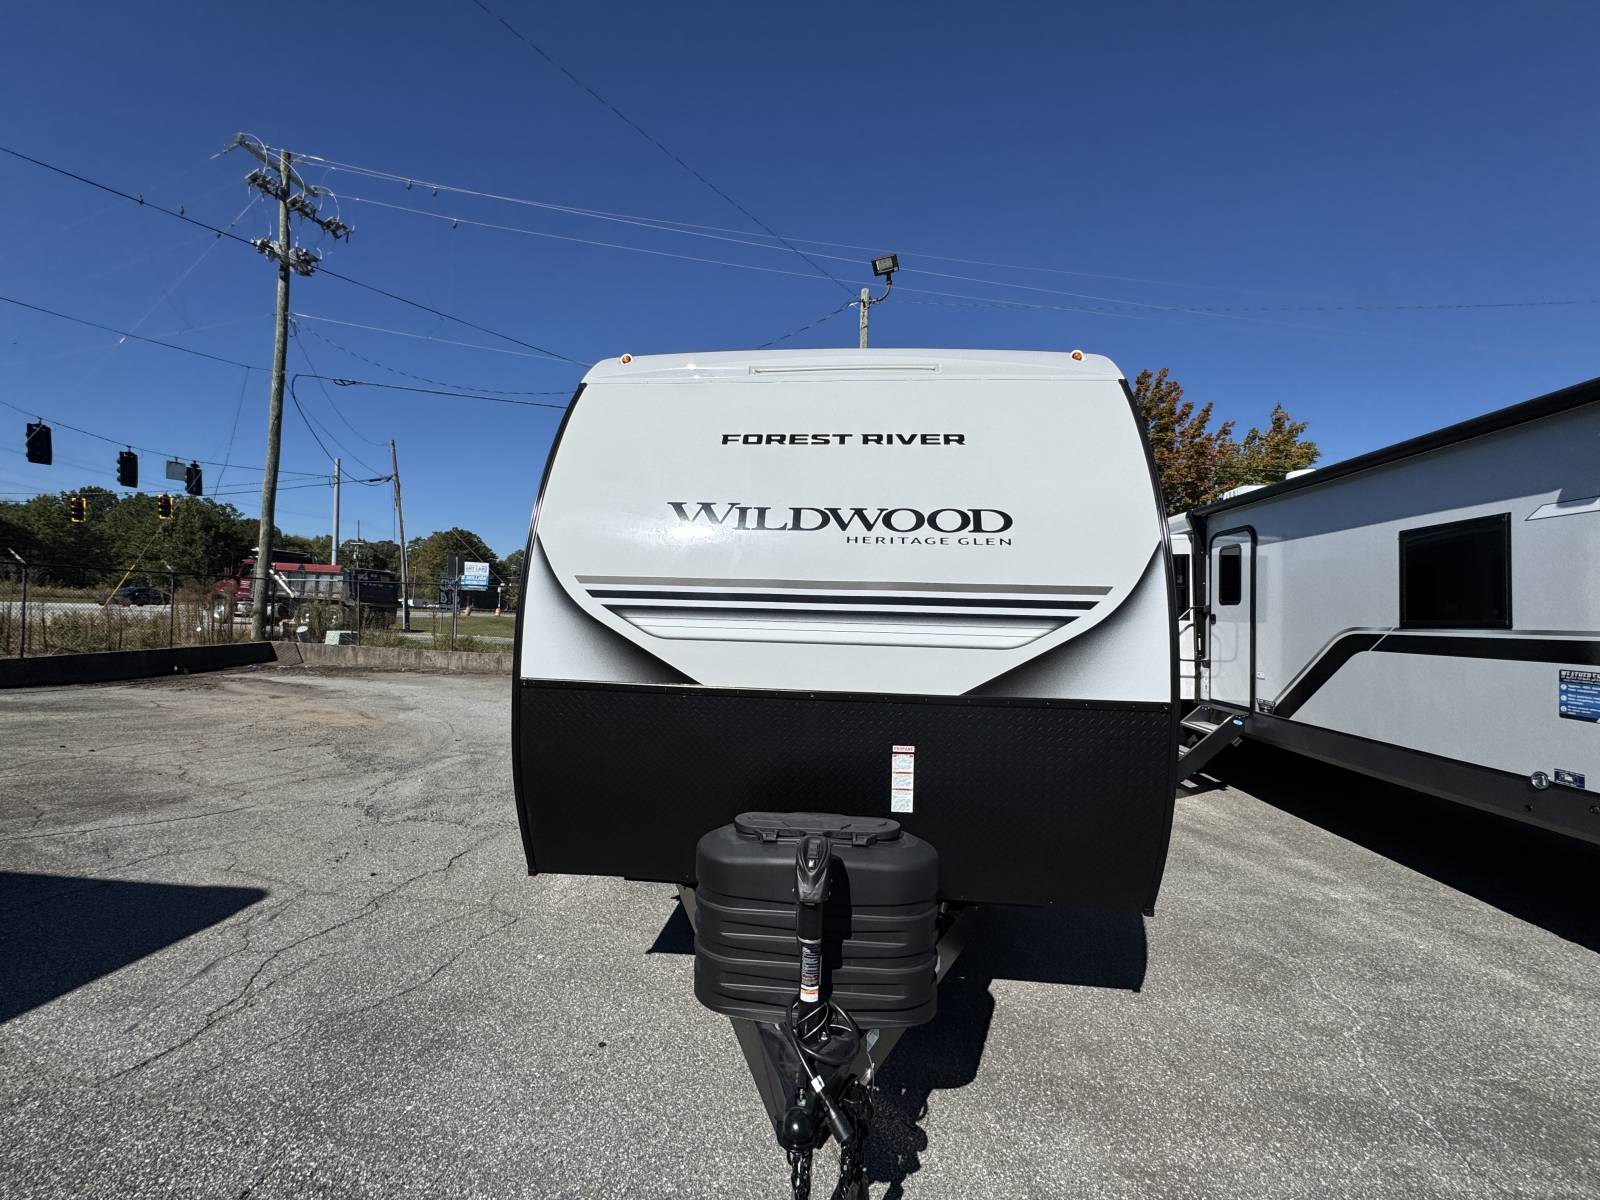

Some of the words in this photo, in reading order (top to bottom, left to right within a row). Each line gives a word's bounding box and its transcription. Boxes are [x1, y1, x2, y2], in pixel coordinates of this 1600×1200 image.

[721, 433, 853, 445] FOREST
[860, 433, 966, 446] RIVER
[667, 501, 1013, 534] WILDWOOD
[846, 536, 950, 546] HERITAGE
[958, 537, 1012, 547] GLEN
